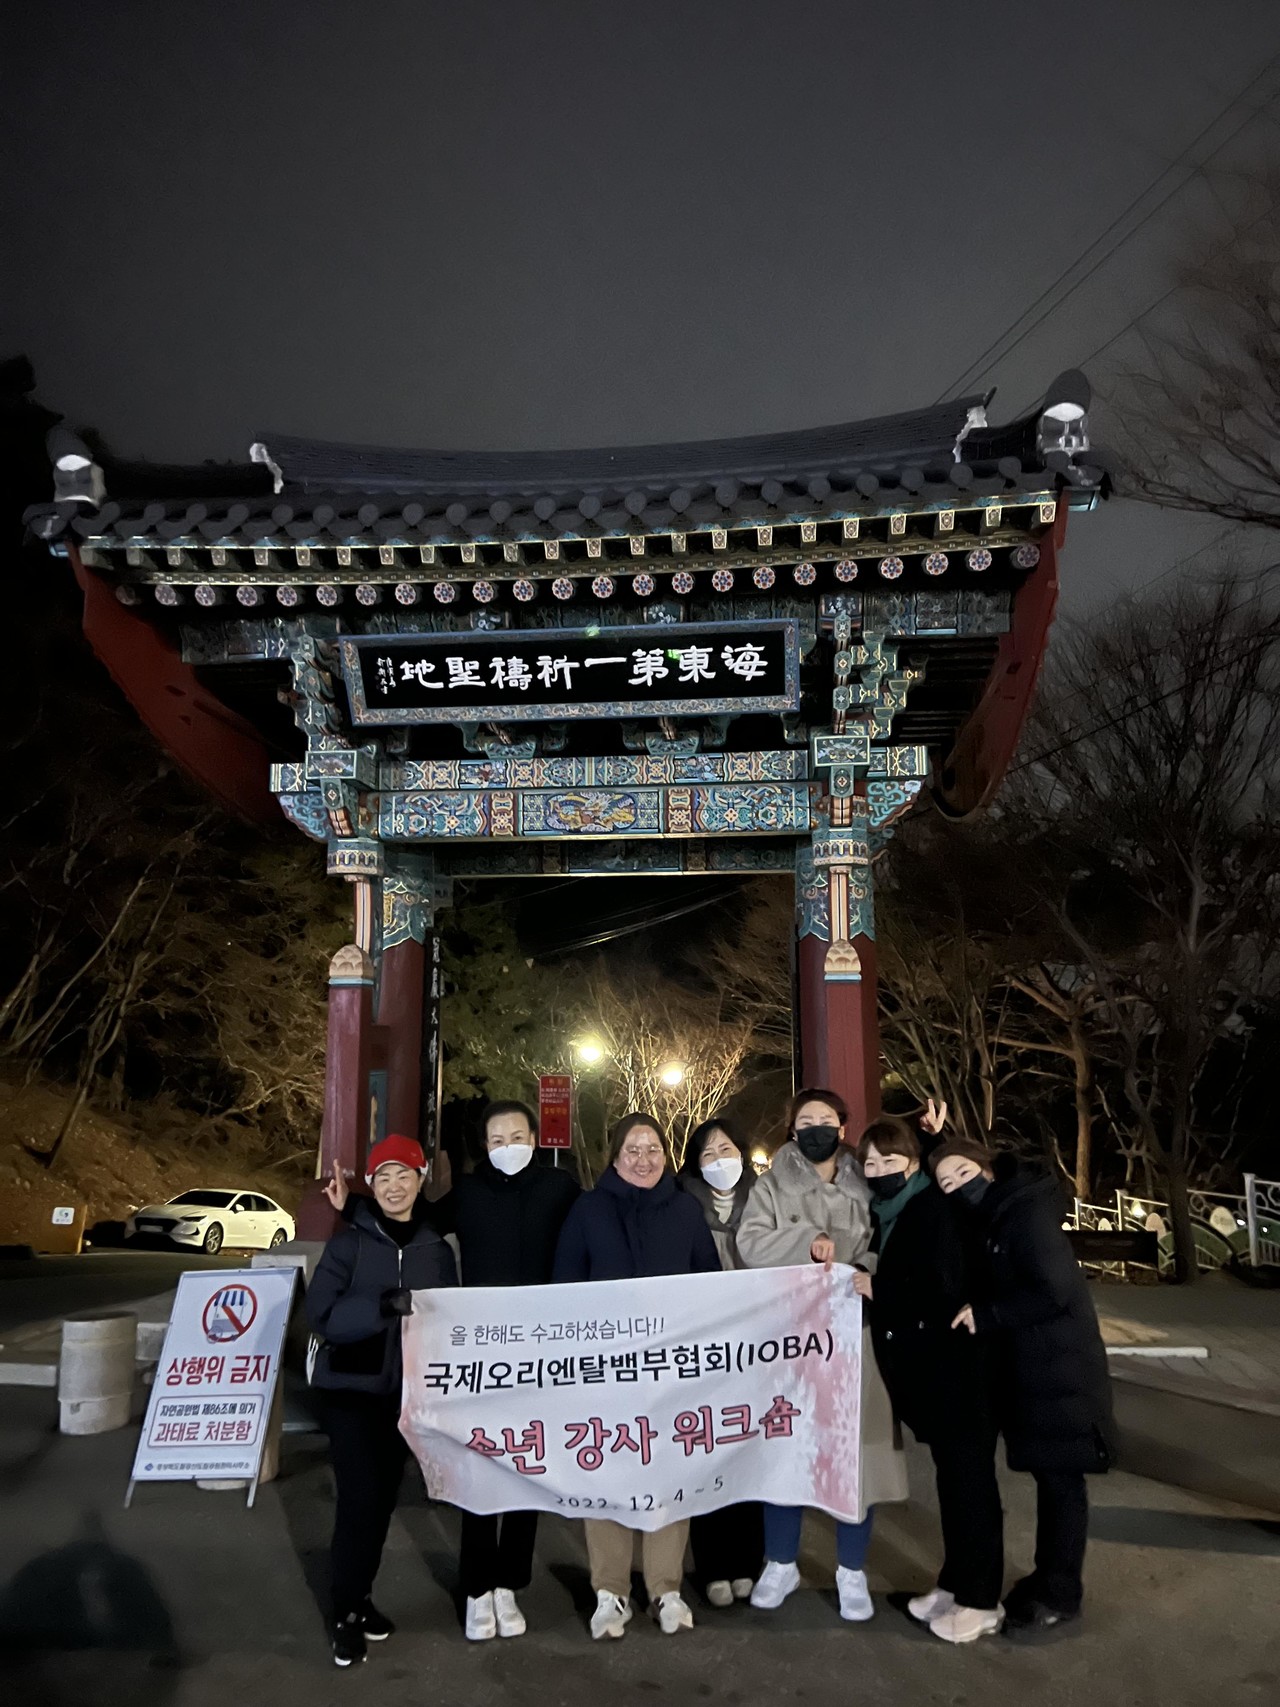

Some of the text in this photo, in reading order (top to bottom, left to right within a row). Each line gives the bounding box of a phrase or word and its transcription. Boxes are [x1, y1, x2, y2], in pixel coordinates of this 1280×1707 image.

[450, 1317, 665, 1346] 올 한해도 수고하셨습니다!!
[166, 1354, 271, 1386] 상행위 금지
[423, 1329, 834, 1395] 국제오리엔탈뱀부협회(IOBA)
[239, 1402, 257, 1415] 의거
[154, 1420, 252, 1442] 과태료 처분함
[564, 1416, 659, 1471] 강사
[672, 1395, 802, 1456] 워크숍
[673, 1488, 684, 1503] 4
[713, 1475, 724, 1492] 5
